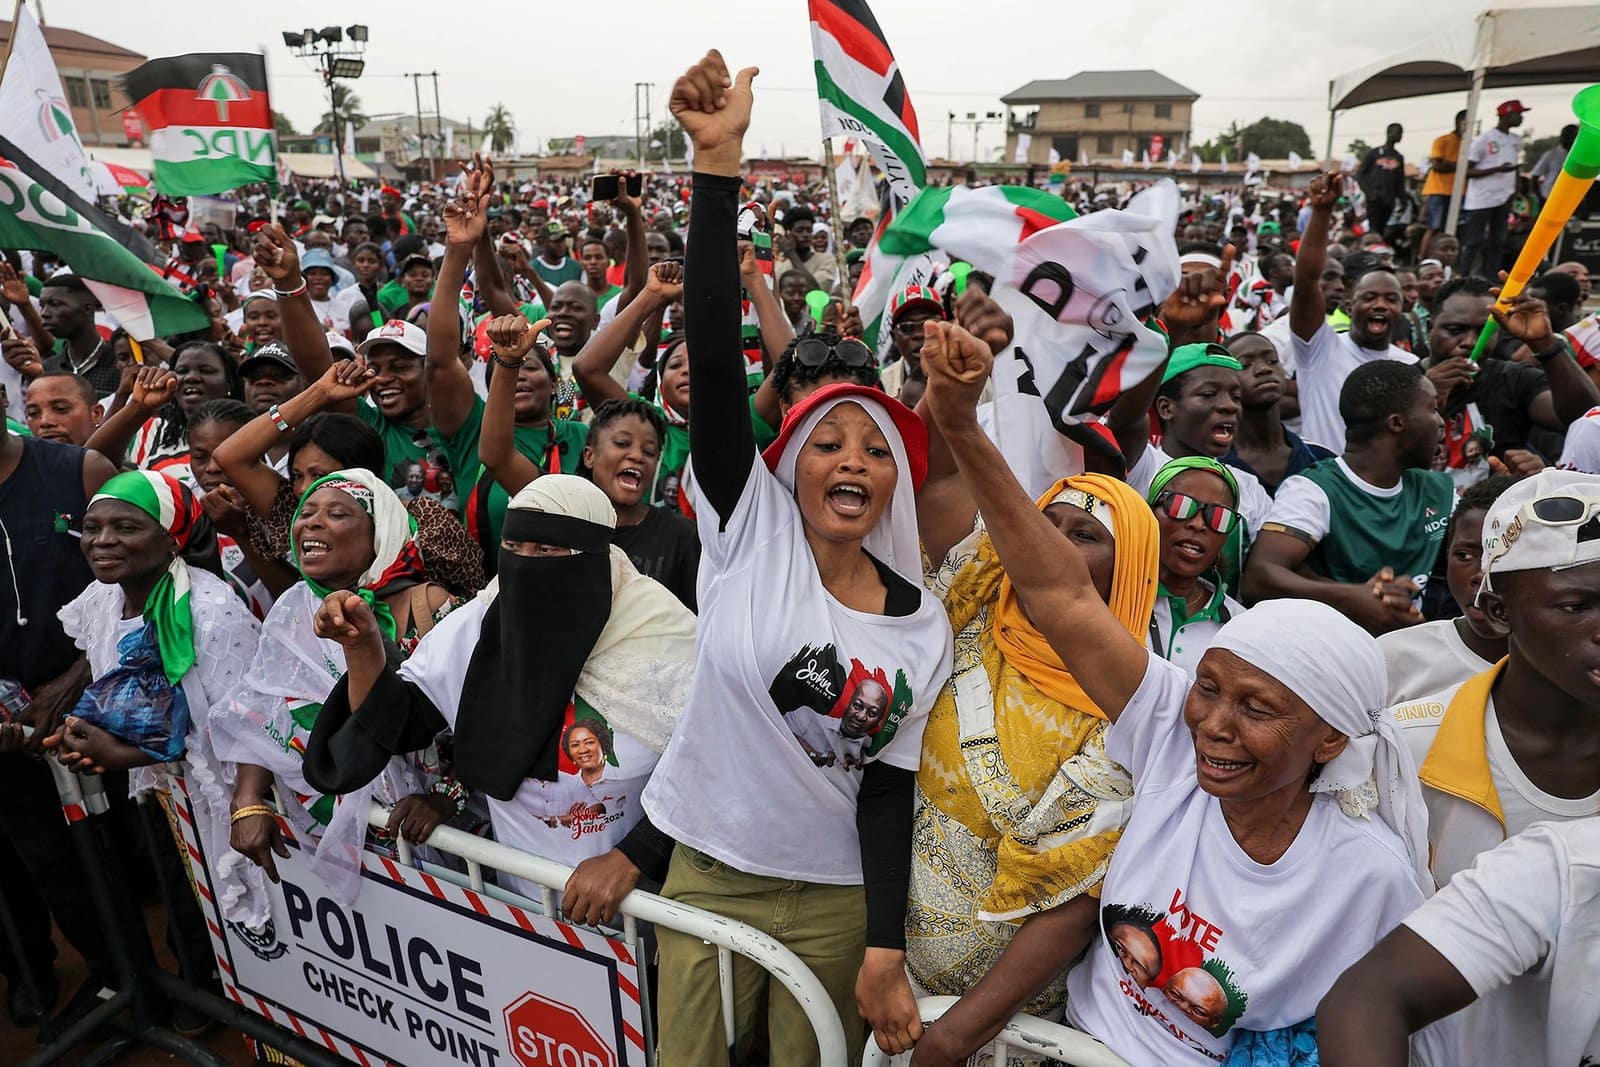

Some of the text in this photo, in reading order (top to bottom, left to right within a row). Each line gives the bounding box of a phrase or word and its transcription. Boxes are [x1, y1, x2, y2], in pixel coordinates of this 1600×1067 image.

[1424, 516, 1449, 534] NDC
[795, 658, 837, 697] John
[571, 810, 625, 840] Jane 2024
[572, 807, 606, 826] John
[281, 880, 492, 1024] POLICE
[303, 961, 500, 1067] CHECK POINT
